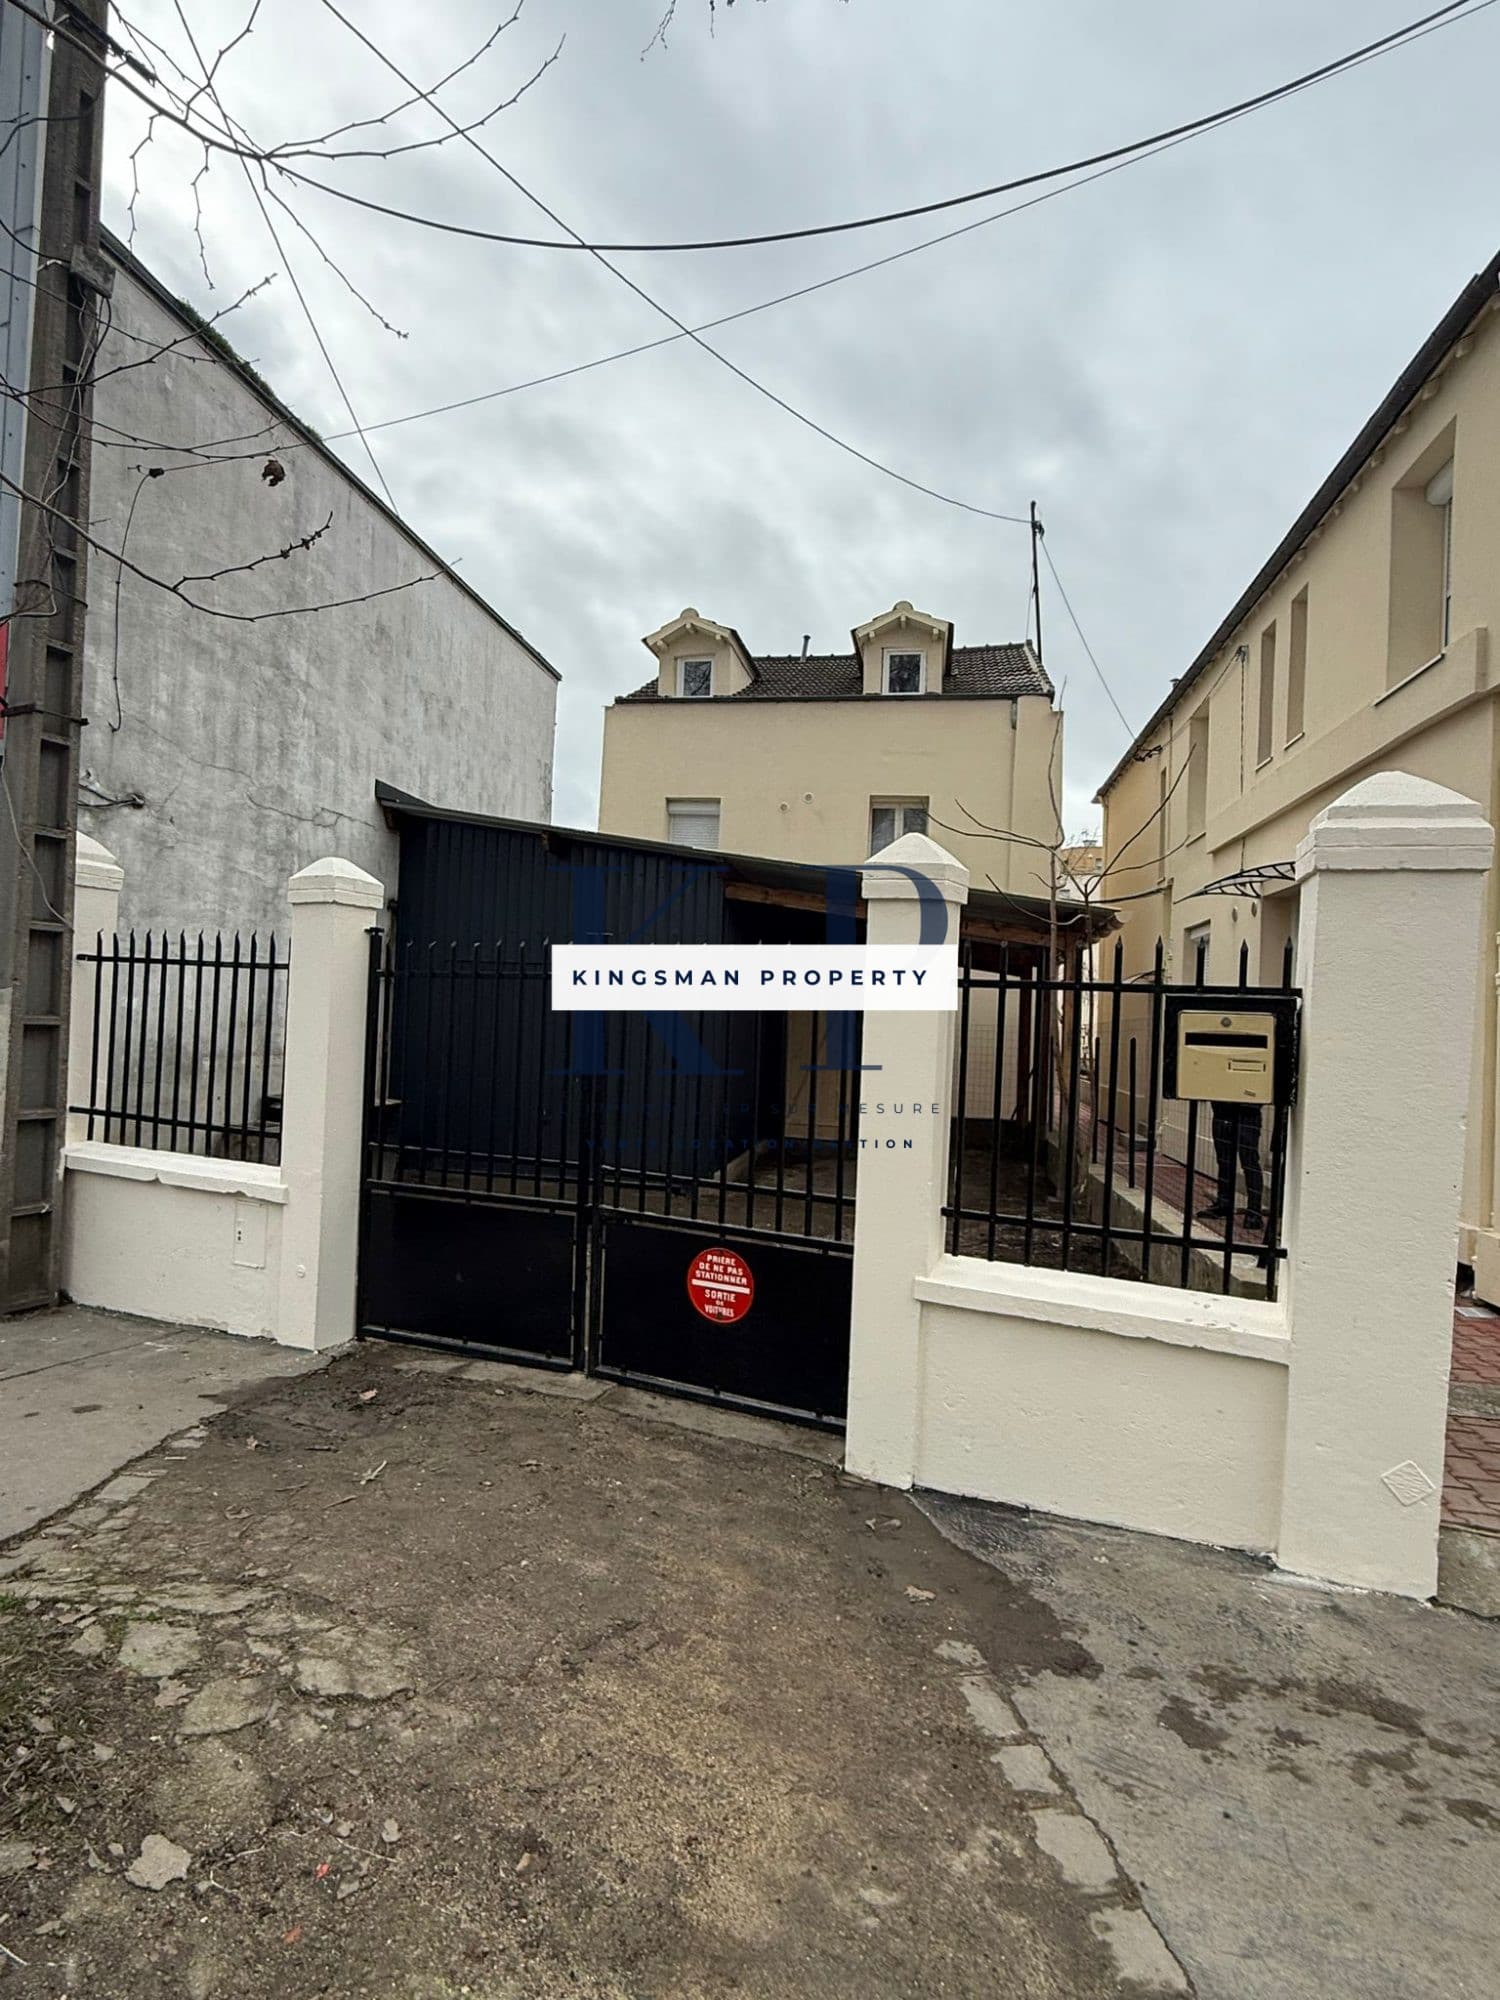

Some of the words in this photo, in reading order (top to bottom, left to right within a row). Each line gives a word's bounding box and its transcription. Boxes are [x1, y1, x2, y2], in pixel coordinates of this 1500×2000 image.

[699, 1262, 711, 1270] DE
[727, 1267, 744, 1276] PAS
[695, 1270, 747, 1285] STATIONNER
[704, 1289, 736, 1302] SORTIE
